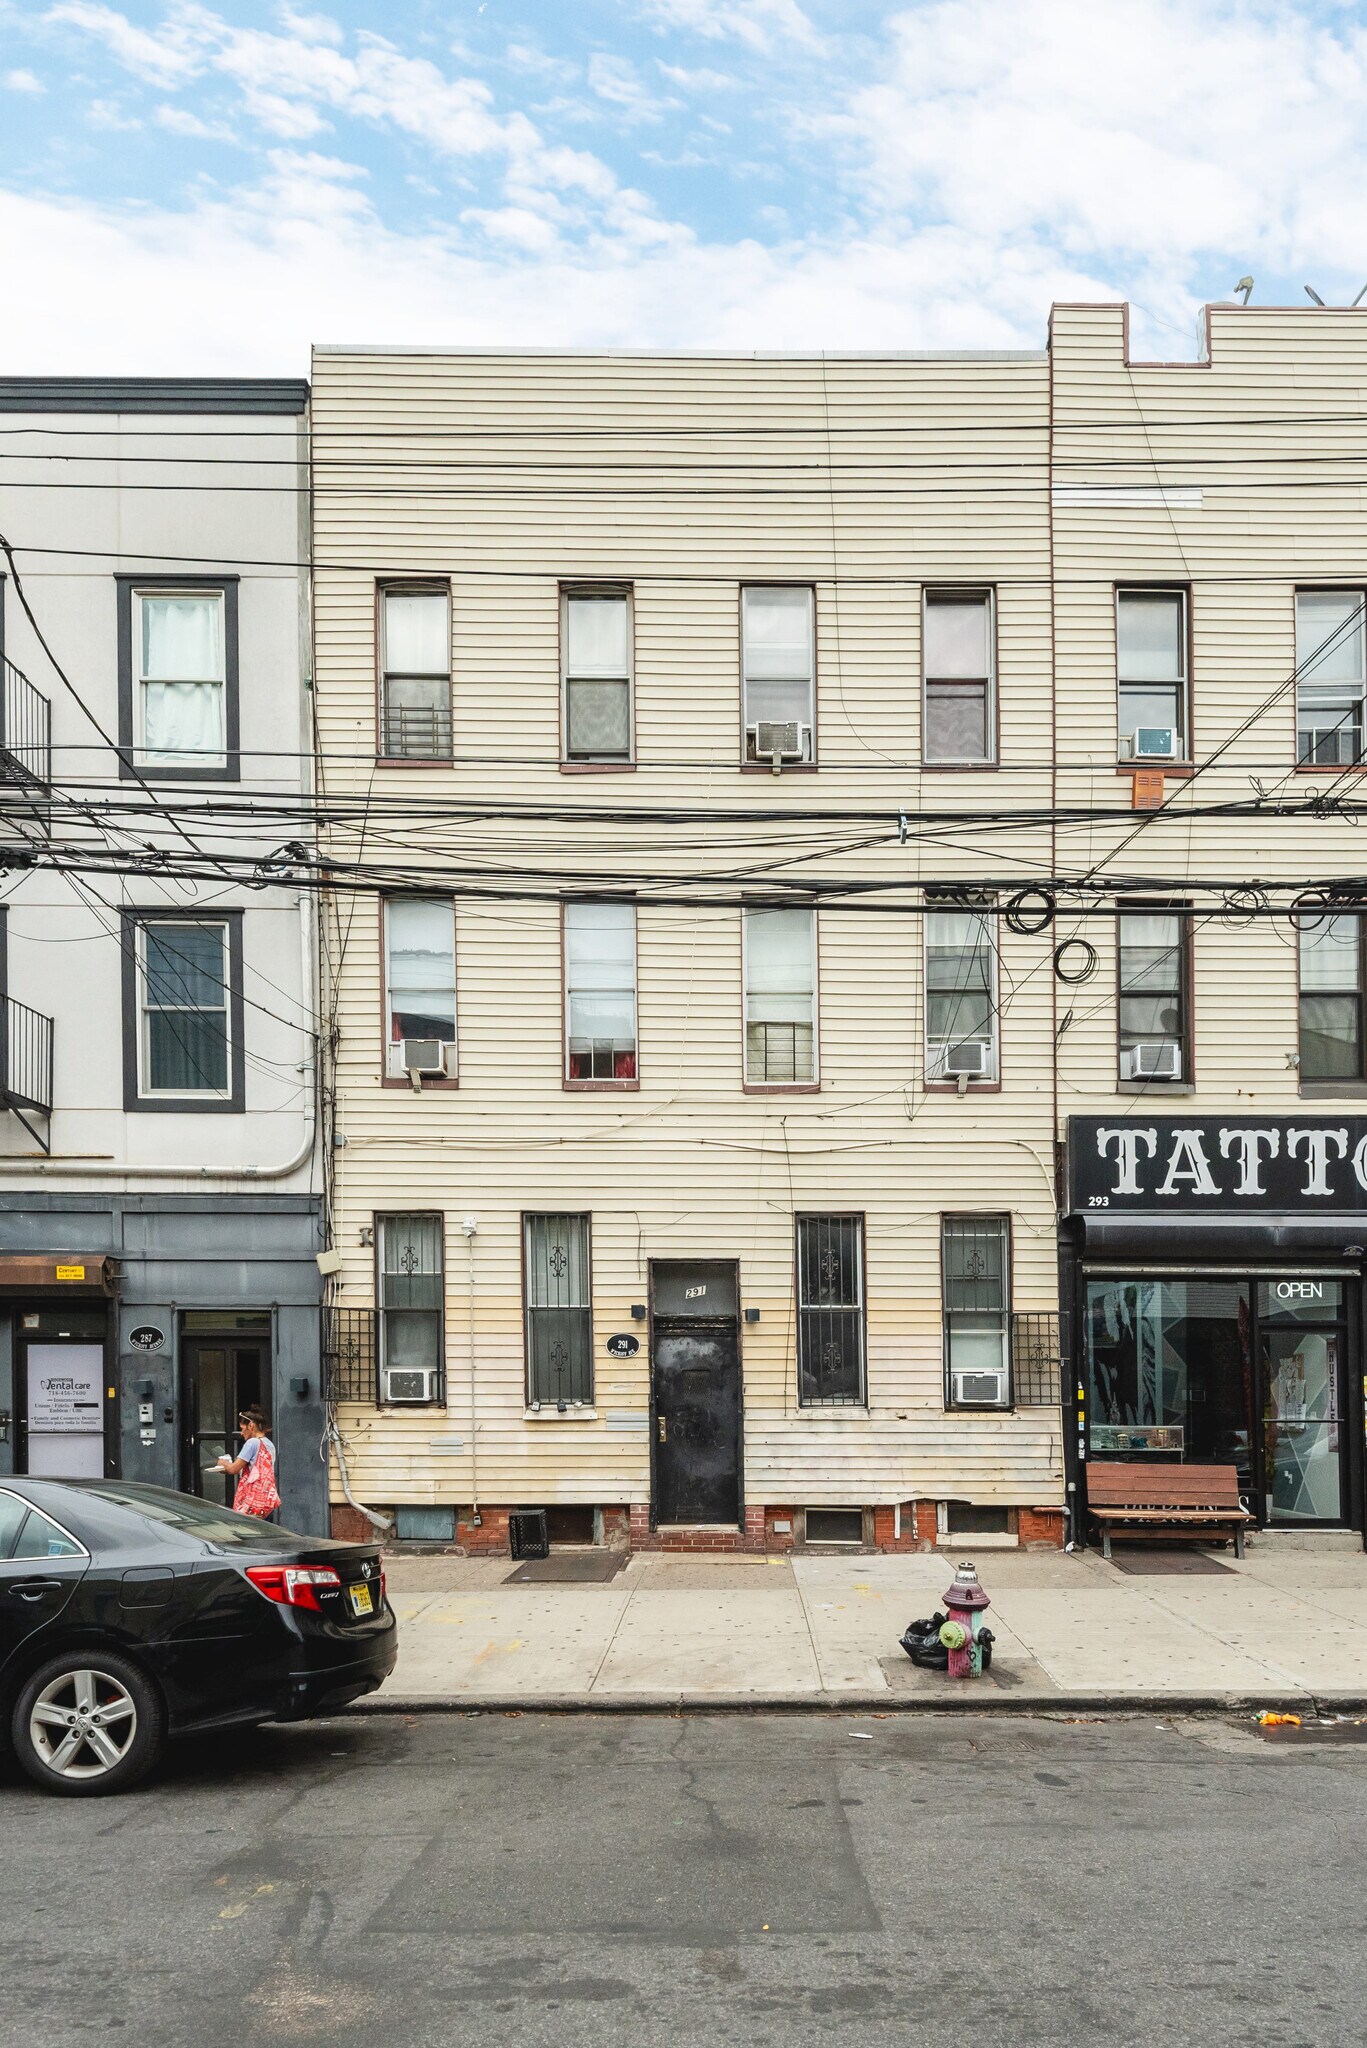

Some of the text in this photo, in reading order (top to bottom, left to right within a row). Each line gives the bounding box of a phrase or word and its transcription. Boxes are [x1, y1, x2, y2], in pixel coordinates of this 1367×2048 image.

[1096, 1127, 1367, 1196] TATT
[1088, 1196, 1109, 1206] 293
[687, 1286, 704, 1298] 291
[1277, 1282, 1323, 1298] OPEN
[140, 1333, 152, 1343] 287
[617, 1339, 628, 1349] 291
